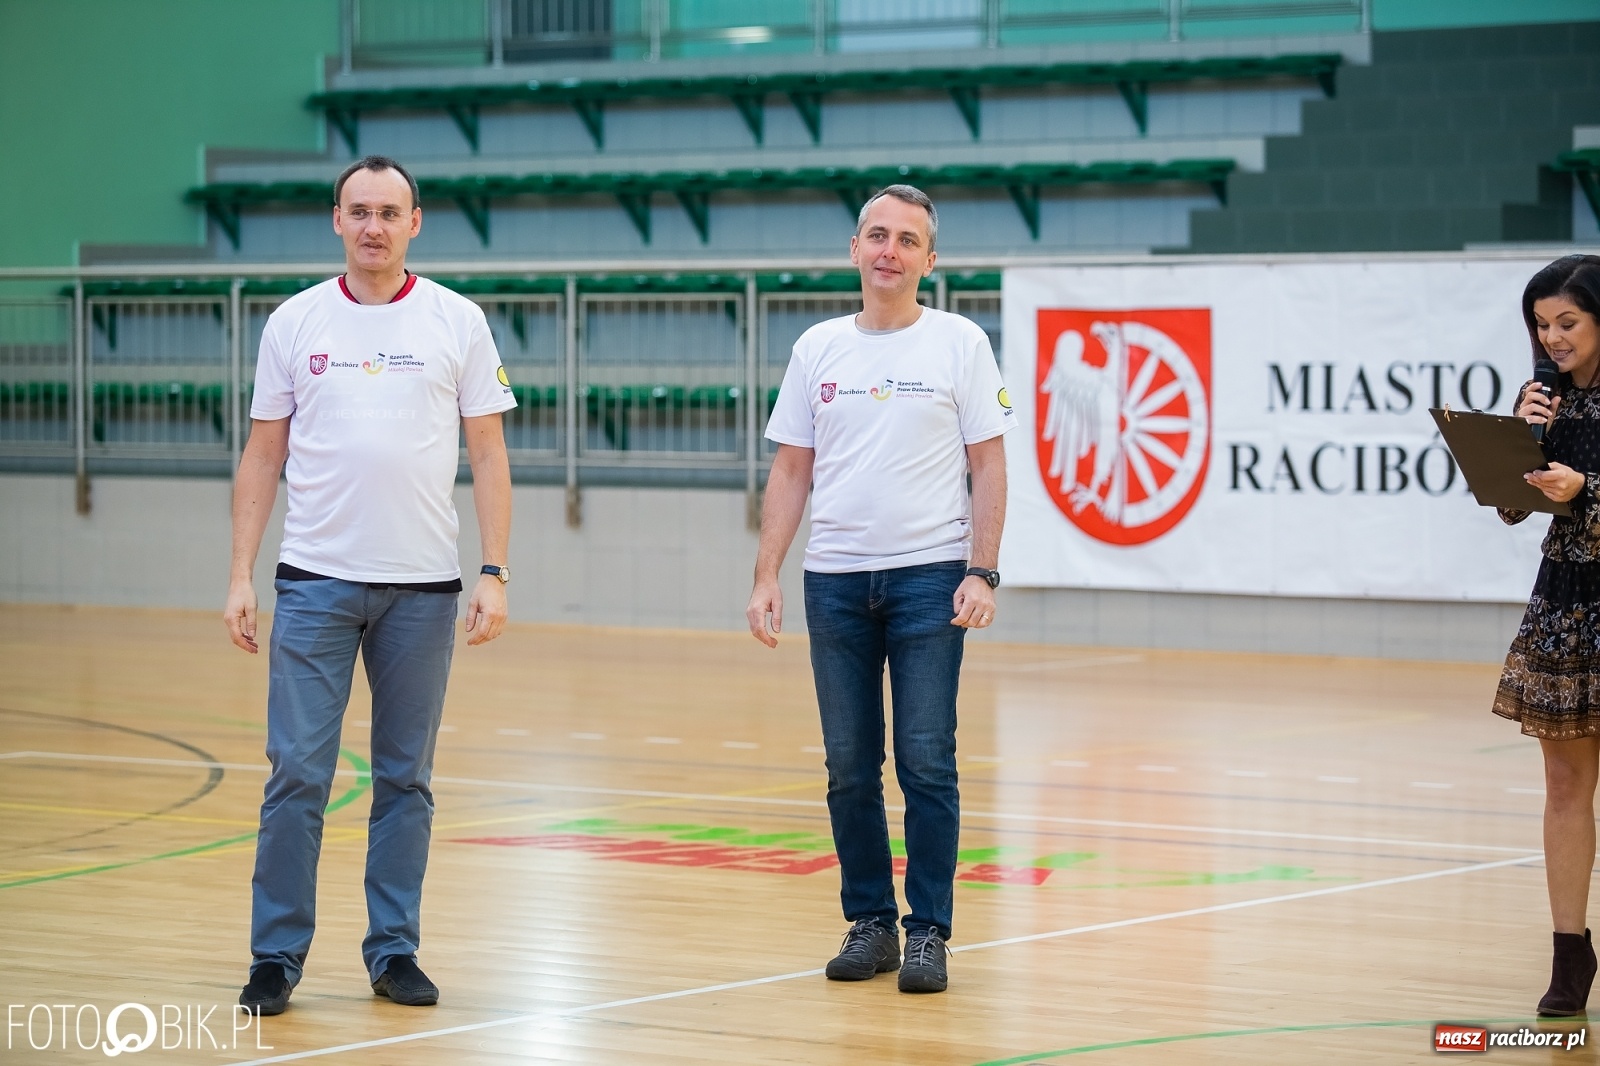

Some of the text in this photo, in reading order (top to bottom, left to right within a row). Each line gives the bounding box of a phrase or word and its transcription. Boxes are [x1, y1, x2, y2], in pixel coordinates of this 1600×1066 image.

[1267, 361, 1502, 414] MIASTO
[320, 408, 418, 421] CHEVROLET
[1229, 431, 1472, 495] RACIBÓ
